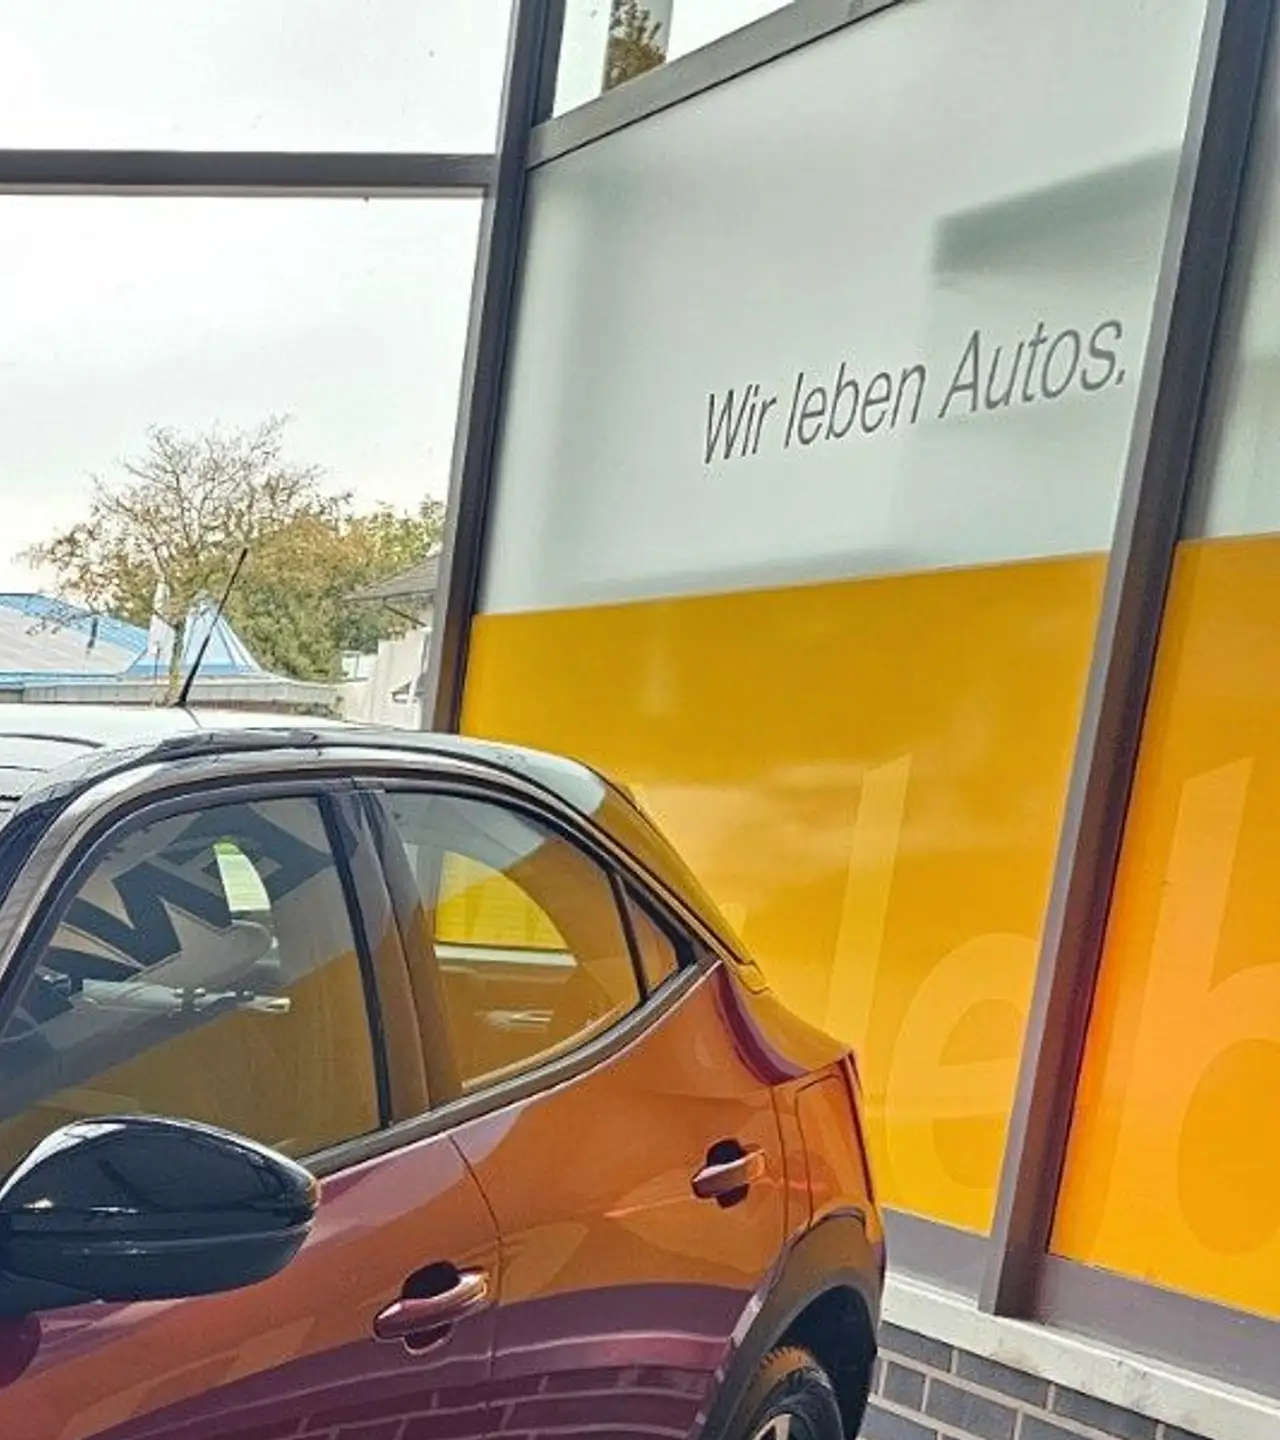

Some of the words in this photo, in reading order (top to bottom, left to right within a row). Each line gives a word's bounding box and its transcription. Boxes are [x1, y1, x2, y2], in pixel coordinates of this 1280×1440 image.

[704, 383, 777, 464] Wir
[783, 362, 927, 450] leben
[938, 319, 1126, 419] Autos.
